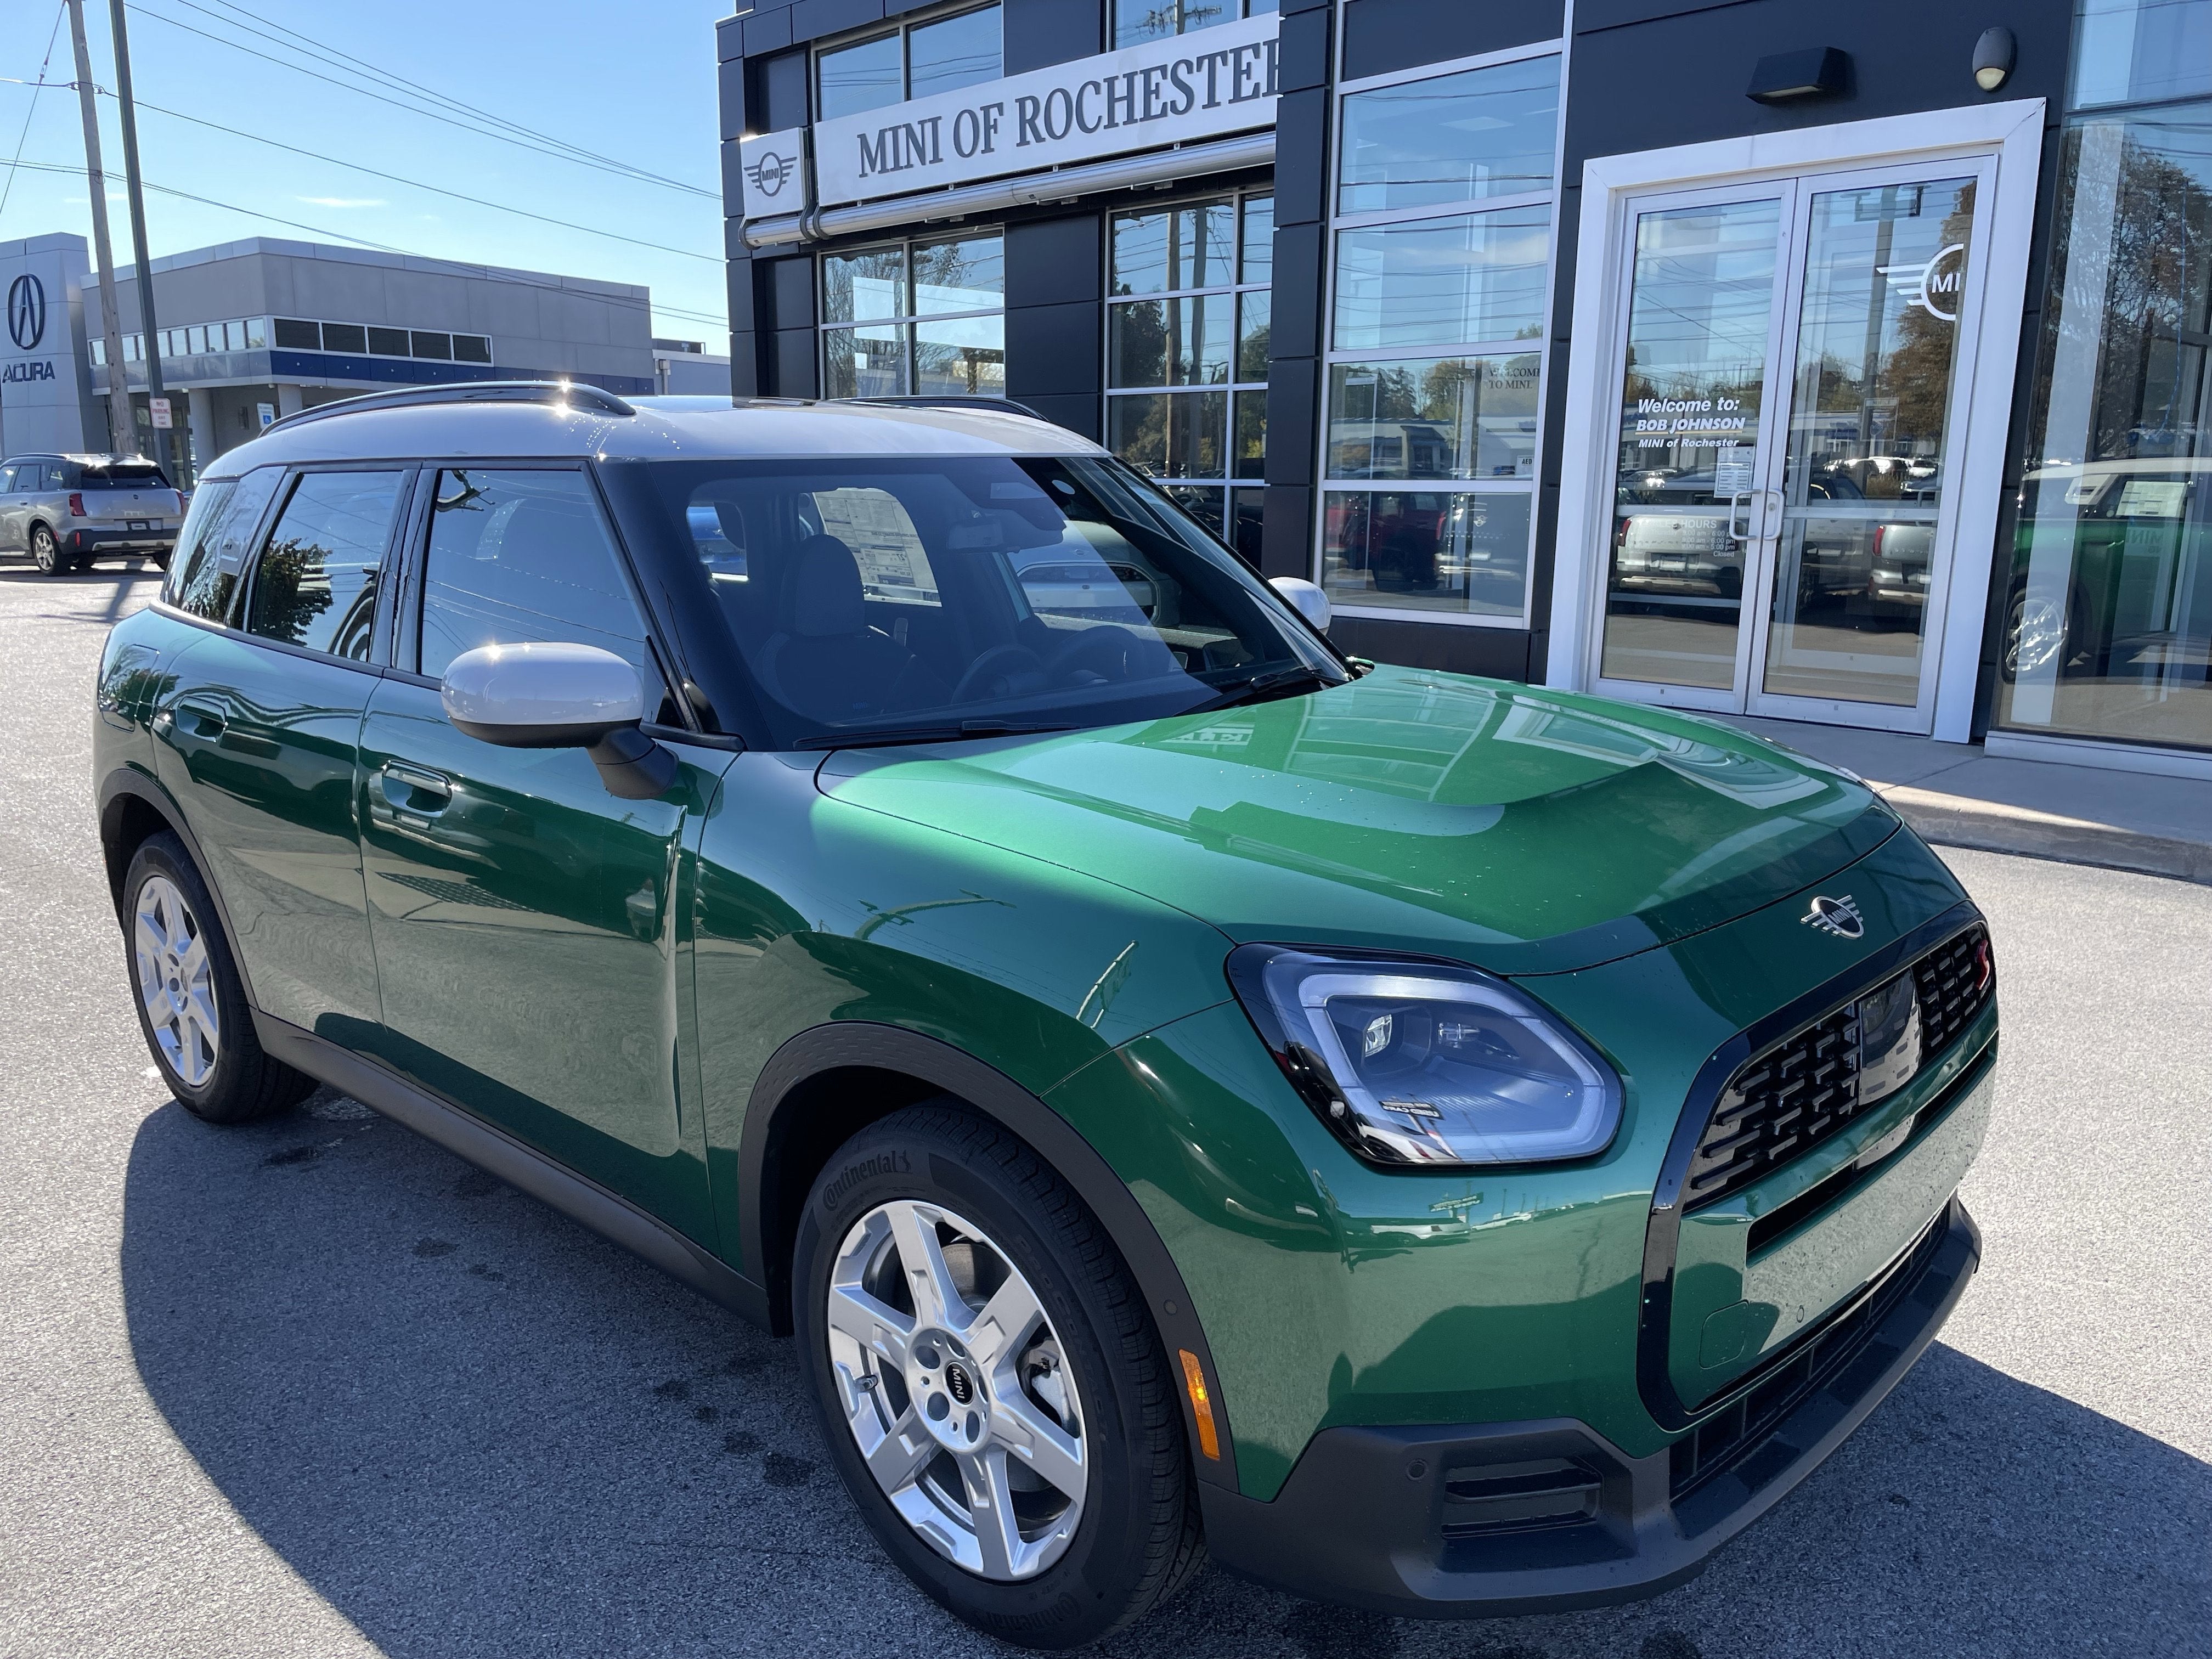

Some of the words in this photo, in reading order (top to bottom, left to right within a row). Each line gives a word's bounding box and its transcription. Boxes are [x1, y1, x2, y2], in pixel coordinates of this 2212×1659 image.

[857, 116, 943, 178] MINI
[952, 103, 1004, 159] OF
[761, 168, 779, 181] MINI
[1931, 273, 1961, 294] MI
[2, 361, 55, 383] ACURA
[1488, 380, 1503, 388] TO
[1638, 398, 1711, 413] Welcome
[1717, 397, 1740, 411] to:
[1636, 419, 1668, 432] BOB
[1669, 417, 1746, 434] JOHNSON
[1638, 439, 1664, 448] MINI
[1666, 438, 1679, 448] of
[1680, 438, 1740, 448] Rochester
[1681, 520, 1717, 529] HOURS
[1827, 907, 1853, 924] MINI
[822, 1150, 898, 1212] Continental
[952, 1368, 966, 1399] MINI
